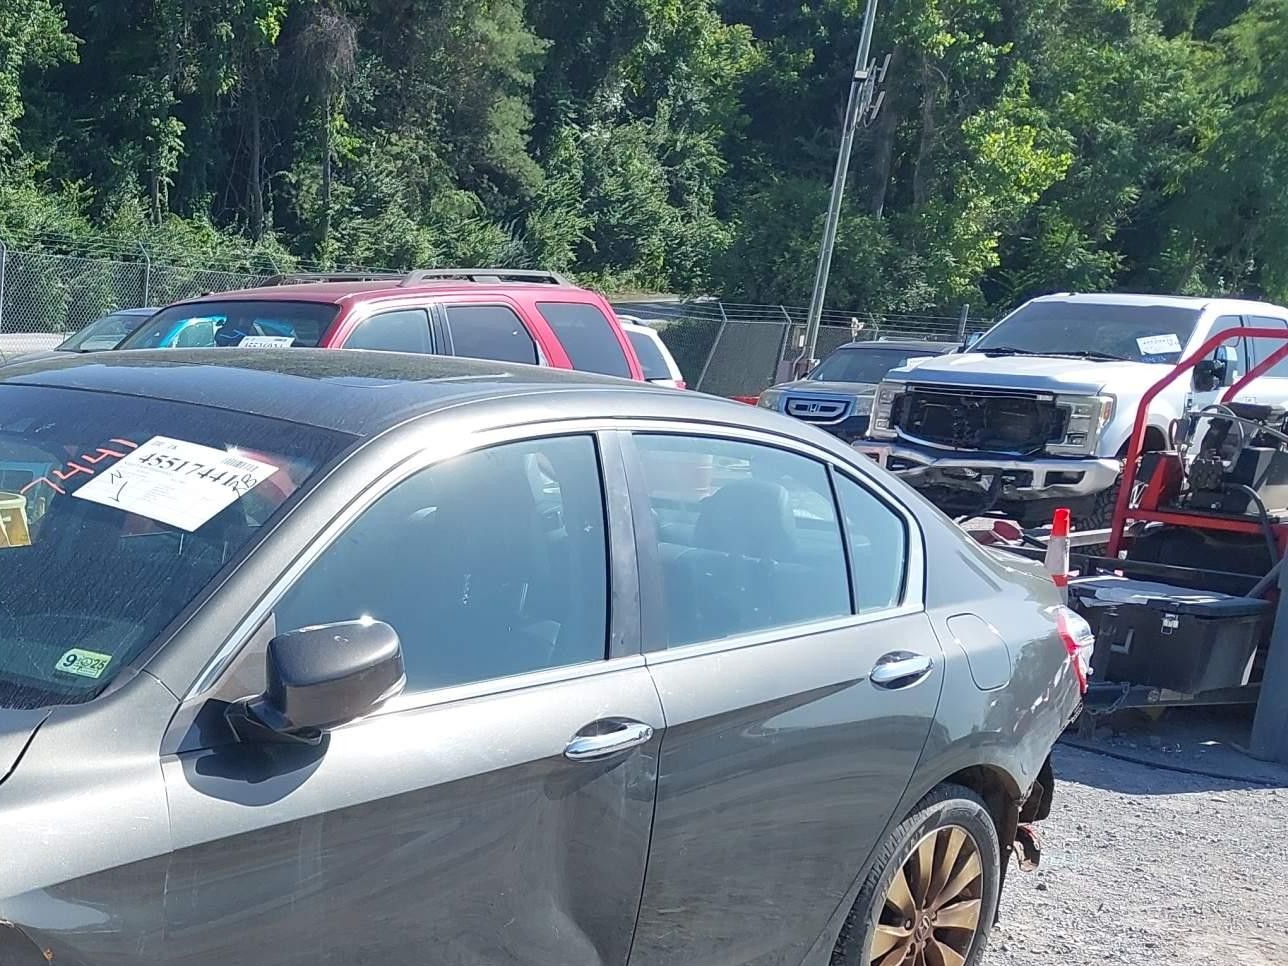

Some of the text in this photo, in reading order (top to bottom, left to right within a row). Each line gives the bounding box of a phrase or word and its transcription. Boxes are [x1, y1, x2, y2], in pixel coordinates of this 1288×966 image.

[139, 453, 239, 487] 45517441
[63, 654, 78, 668] 9
[90, 658, 108, 670] 25
